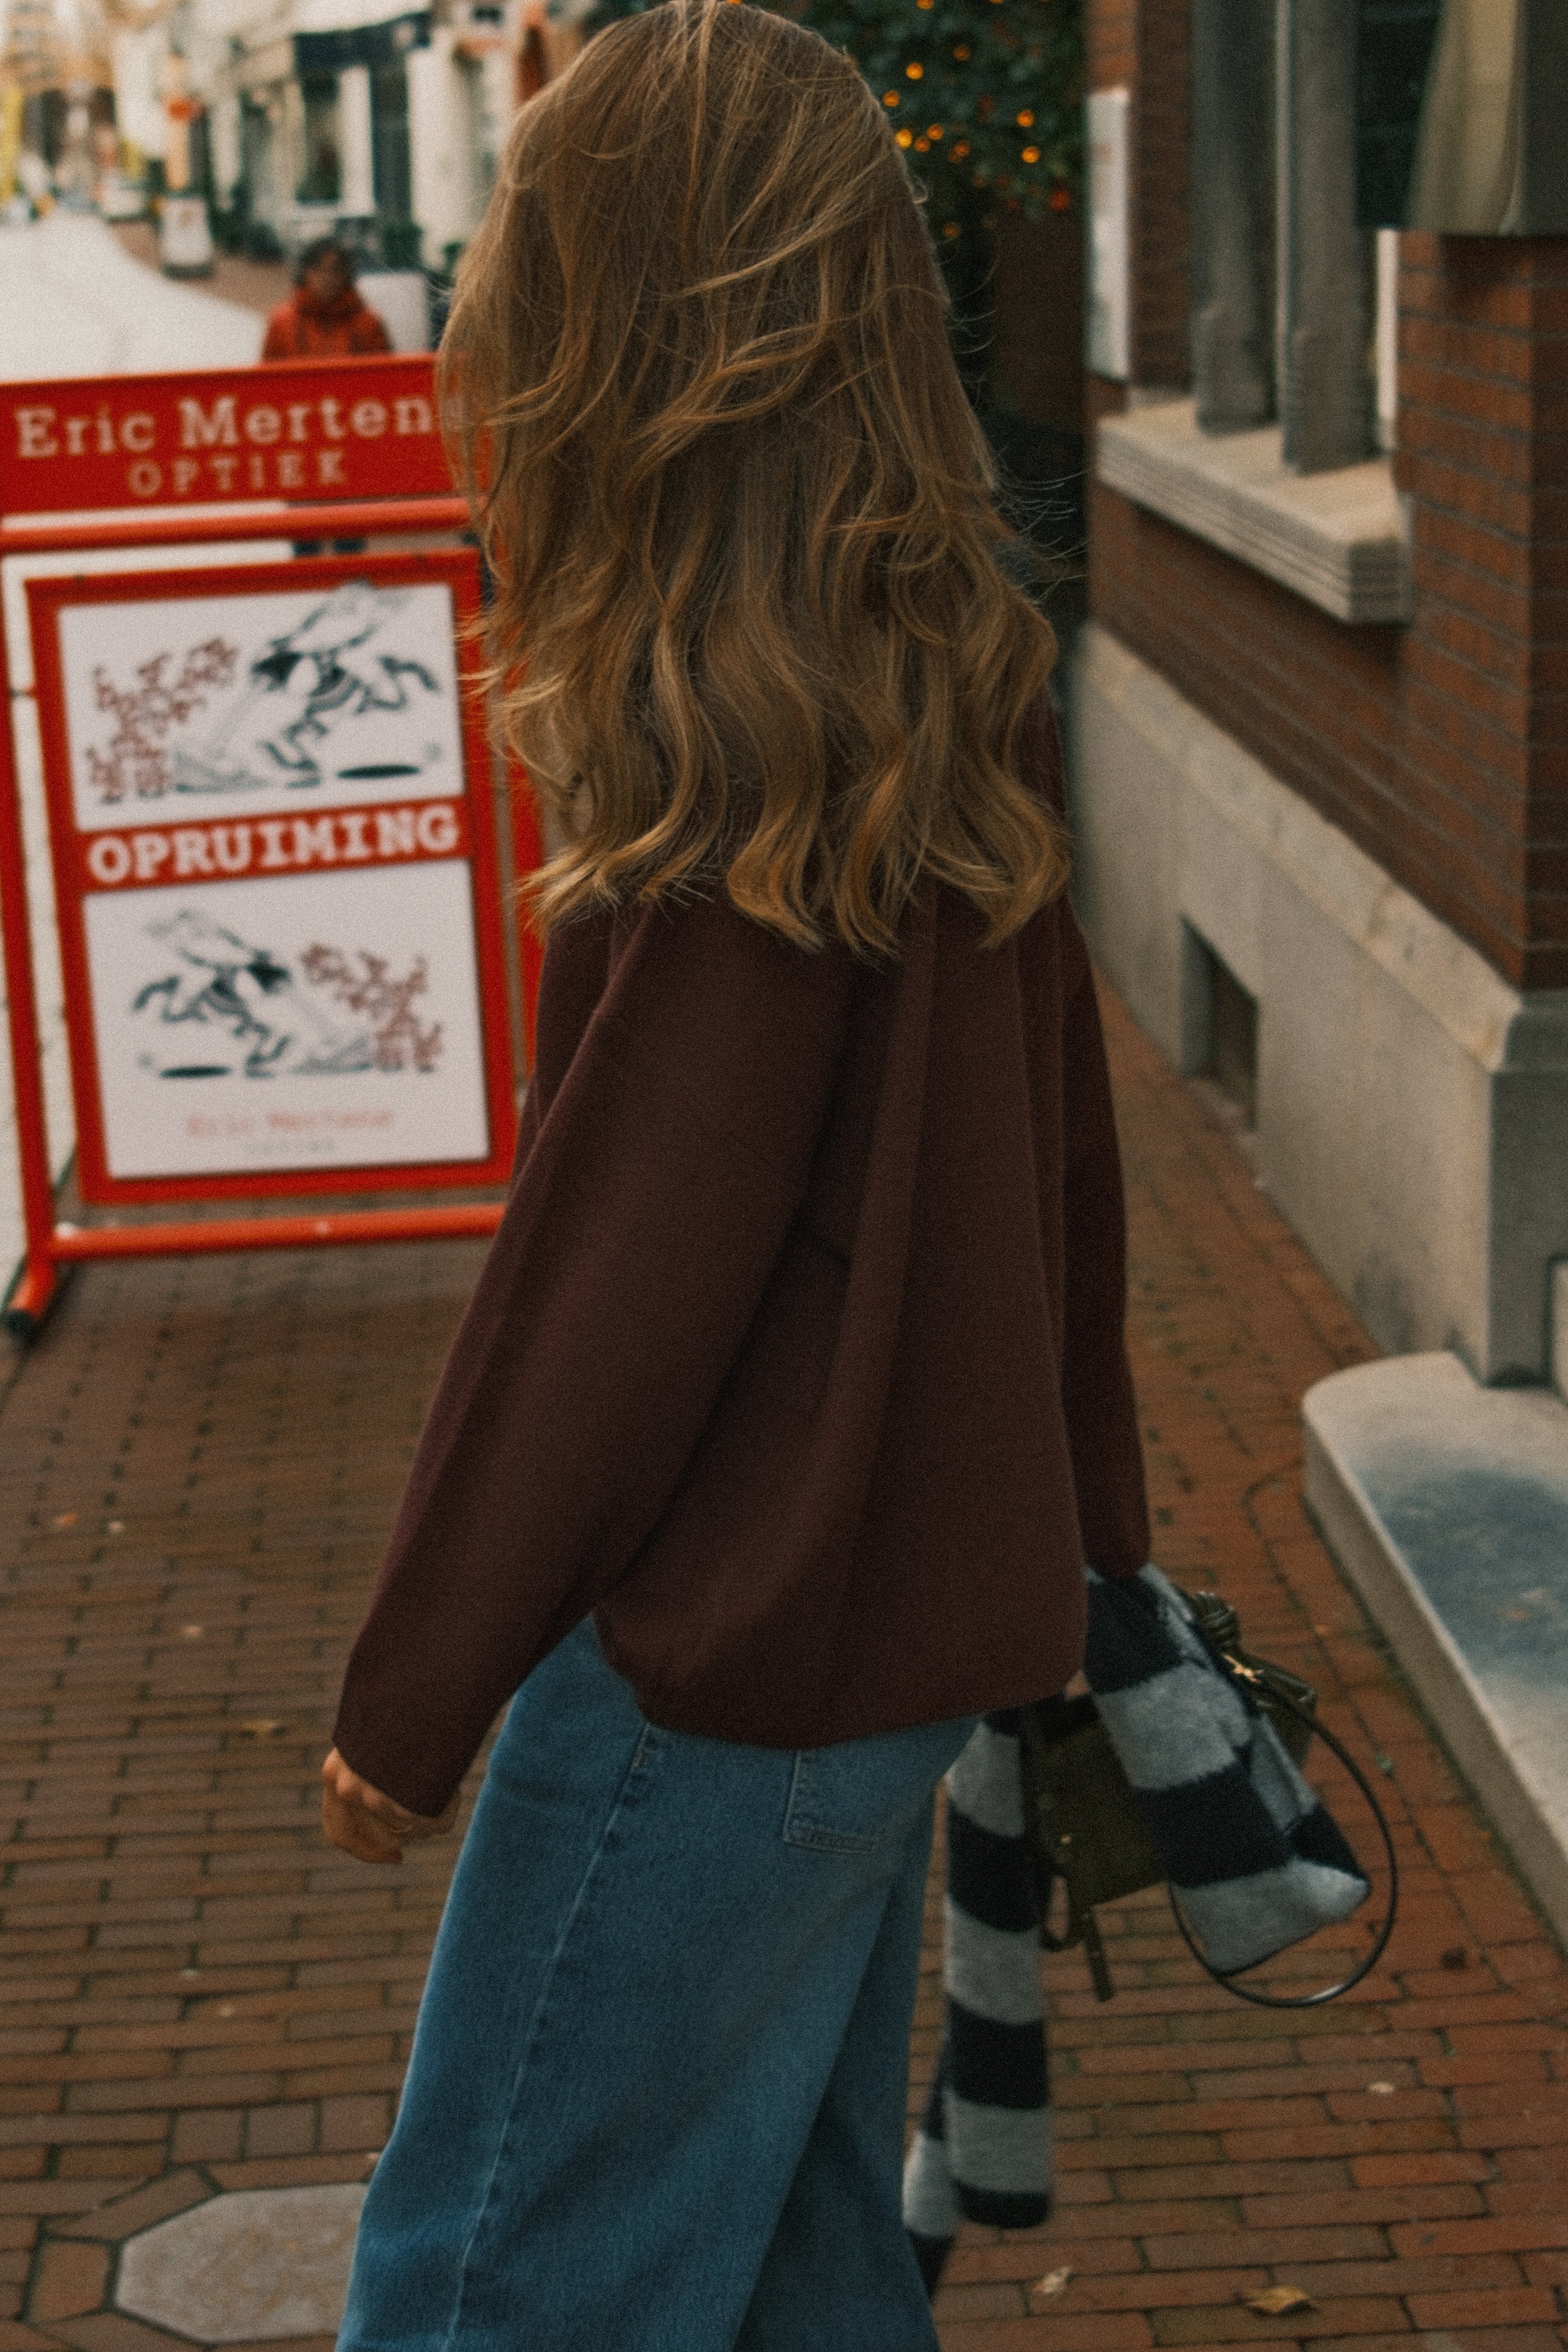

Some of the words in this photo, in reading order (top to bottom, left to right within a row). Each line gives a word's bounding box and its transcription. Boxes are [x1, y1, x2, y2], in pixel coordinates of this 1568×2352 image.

[16, 404, 156, 458] Eric
[128, 449, 347, 497] OPTIEK
[88, 805, 459, 882] OPRUIMING
